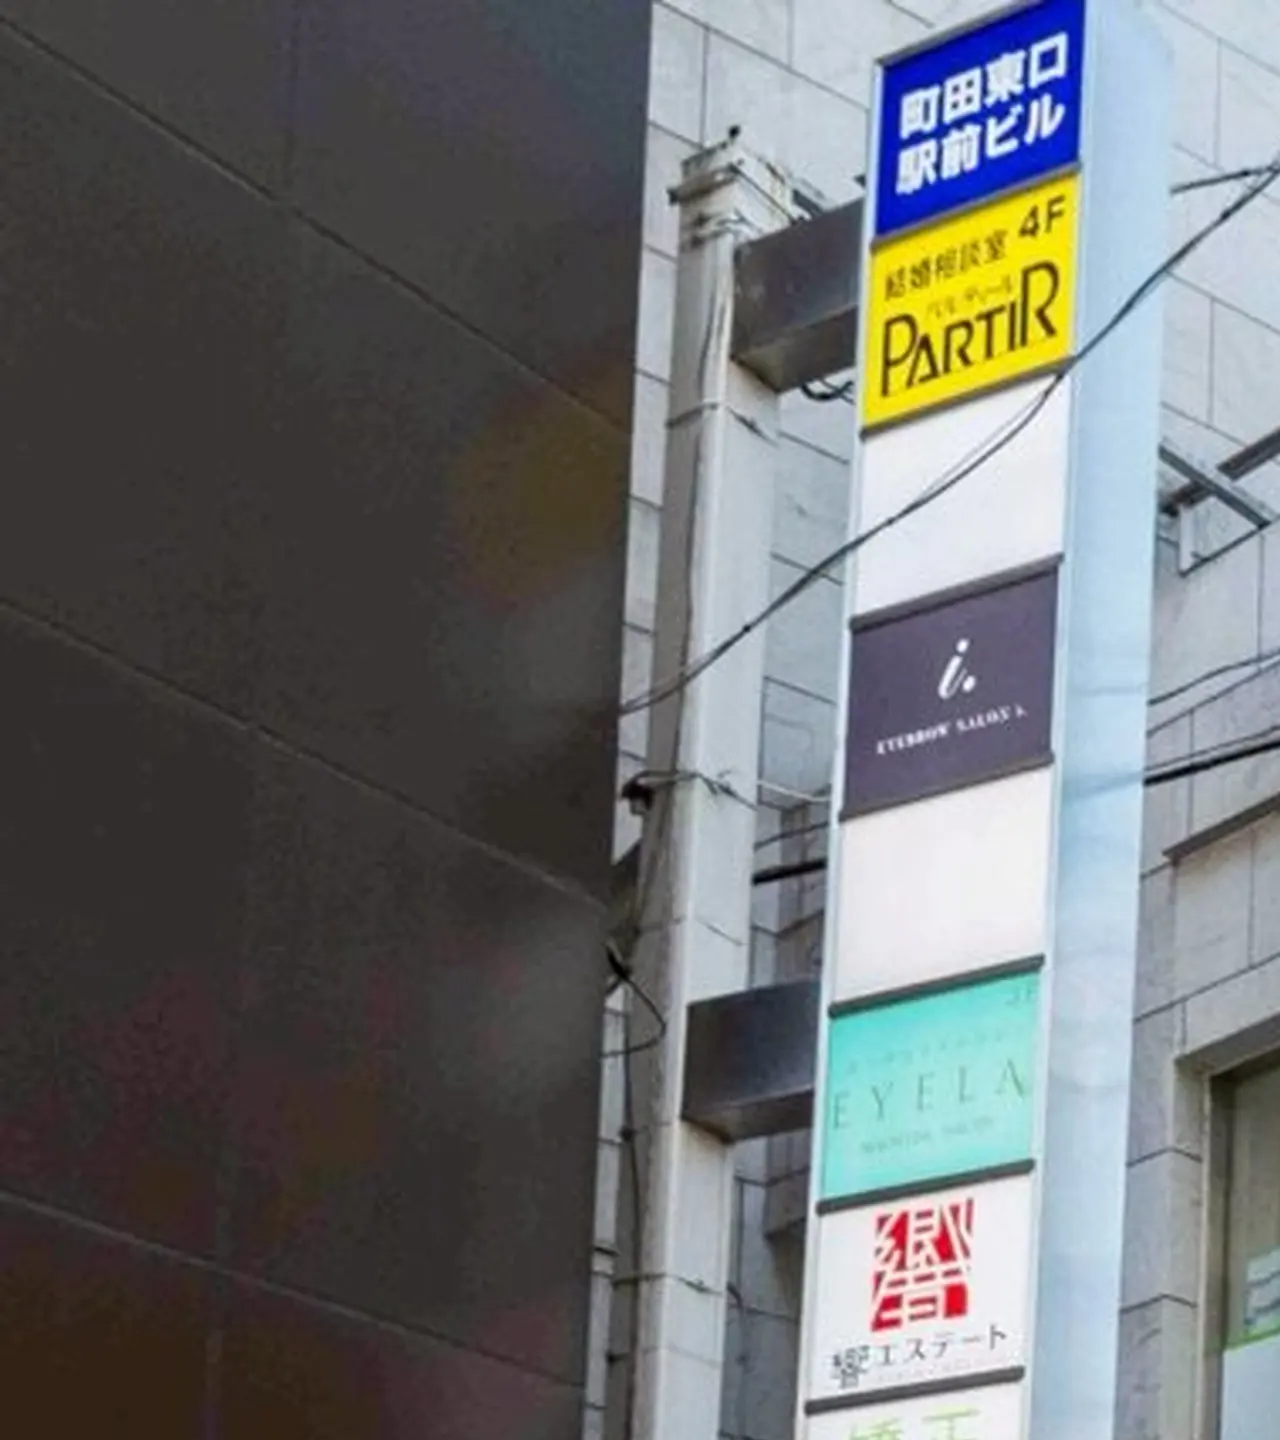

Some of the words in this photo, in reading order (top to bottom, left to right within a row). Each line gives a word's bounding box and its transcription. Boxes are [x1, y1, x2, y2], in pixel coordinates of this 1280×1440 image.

[899, 32, 1068, 140] 町田東口
[896, 93, 1065, 194] 駅前ビル
[1019, 195, 1066, 238] 4F
